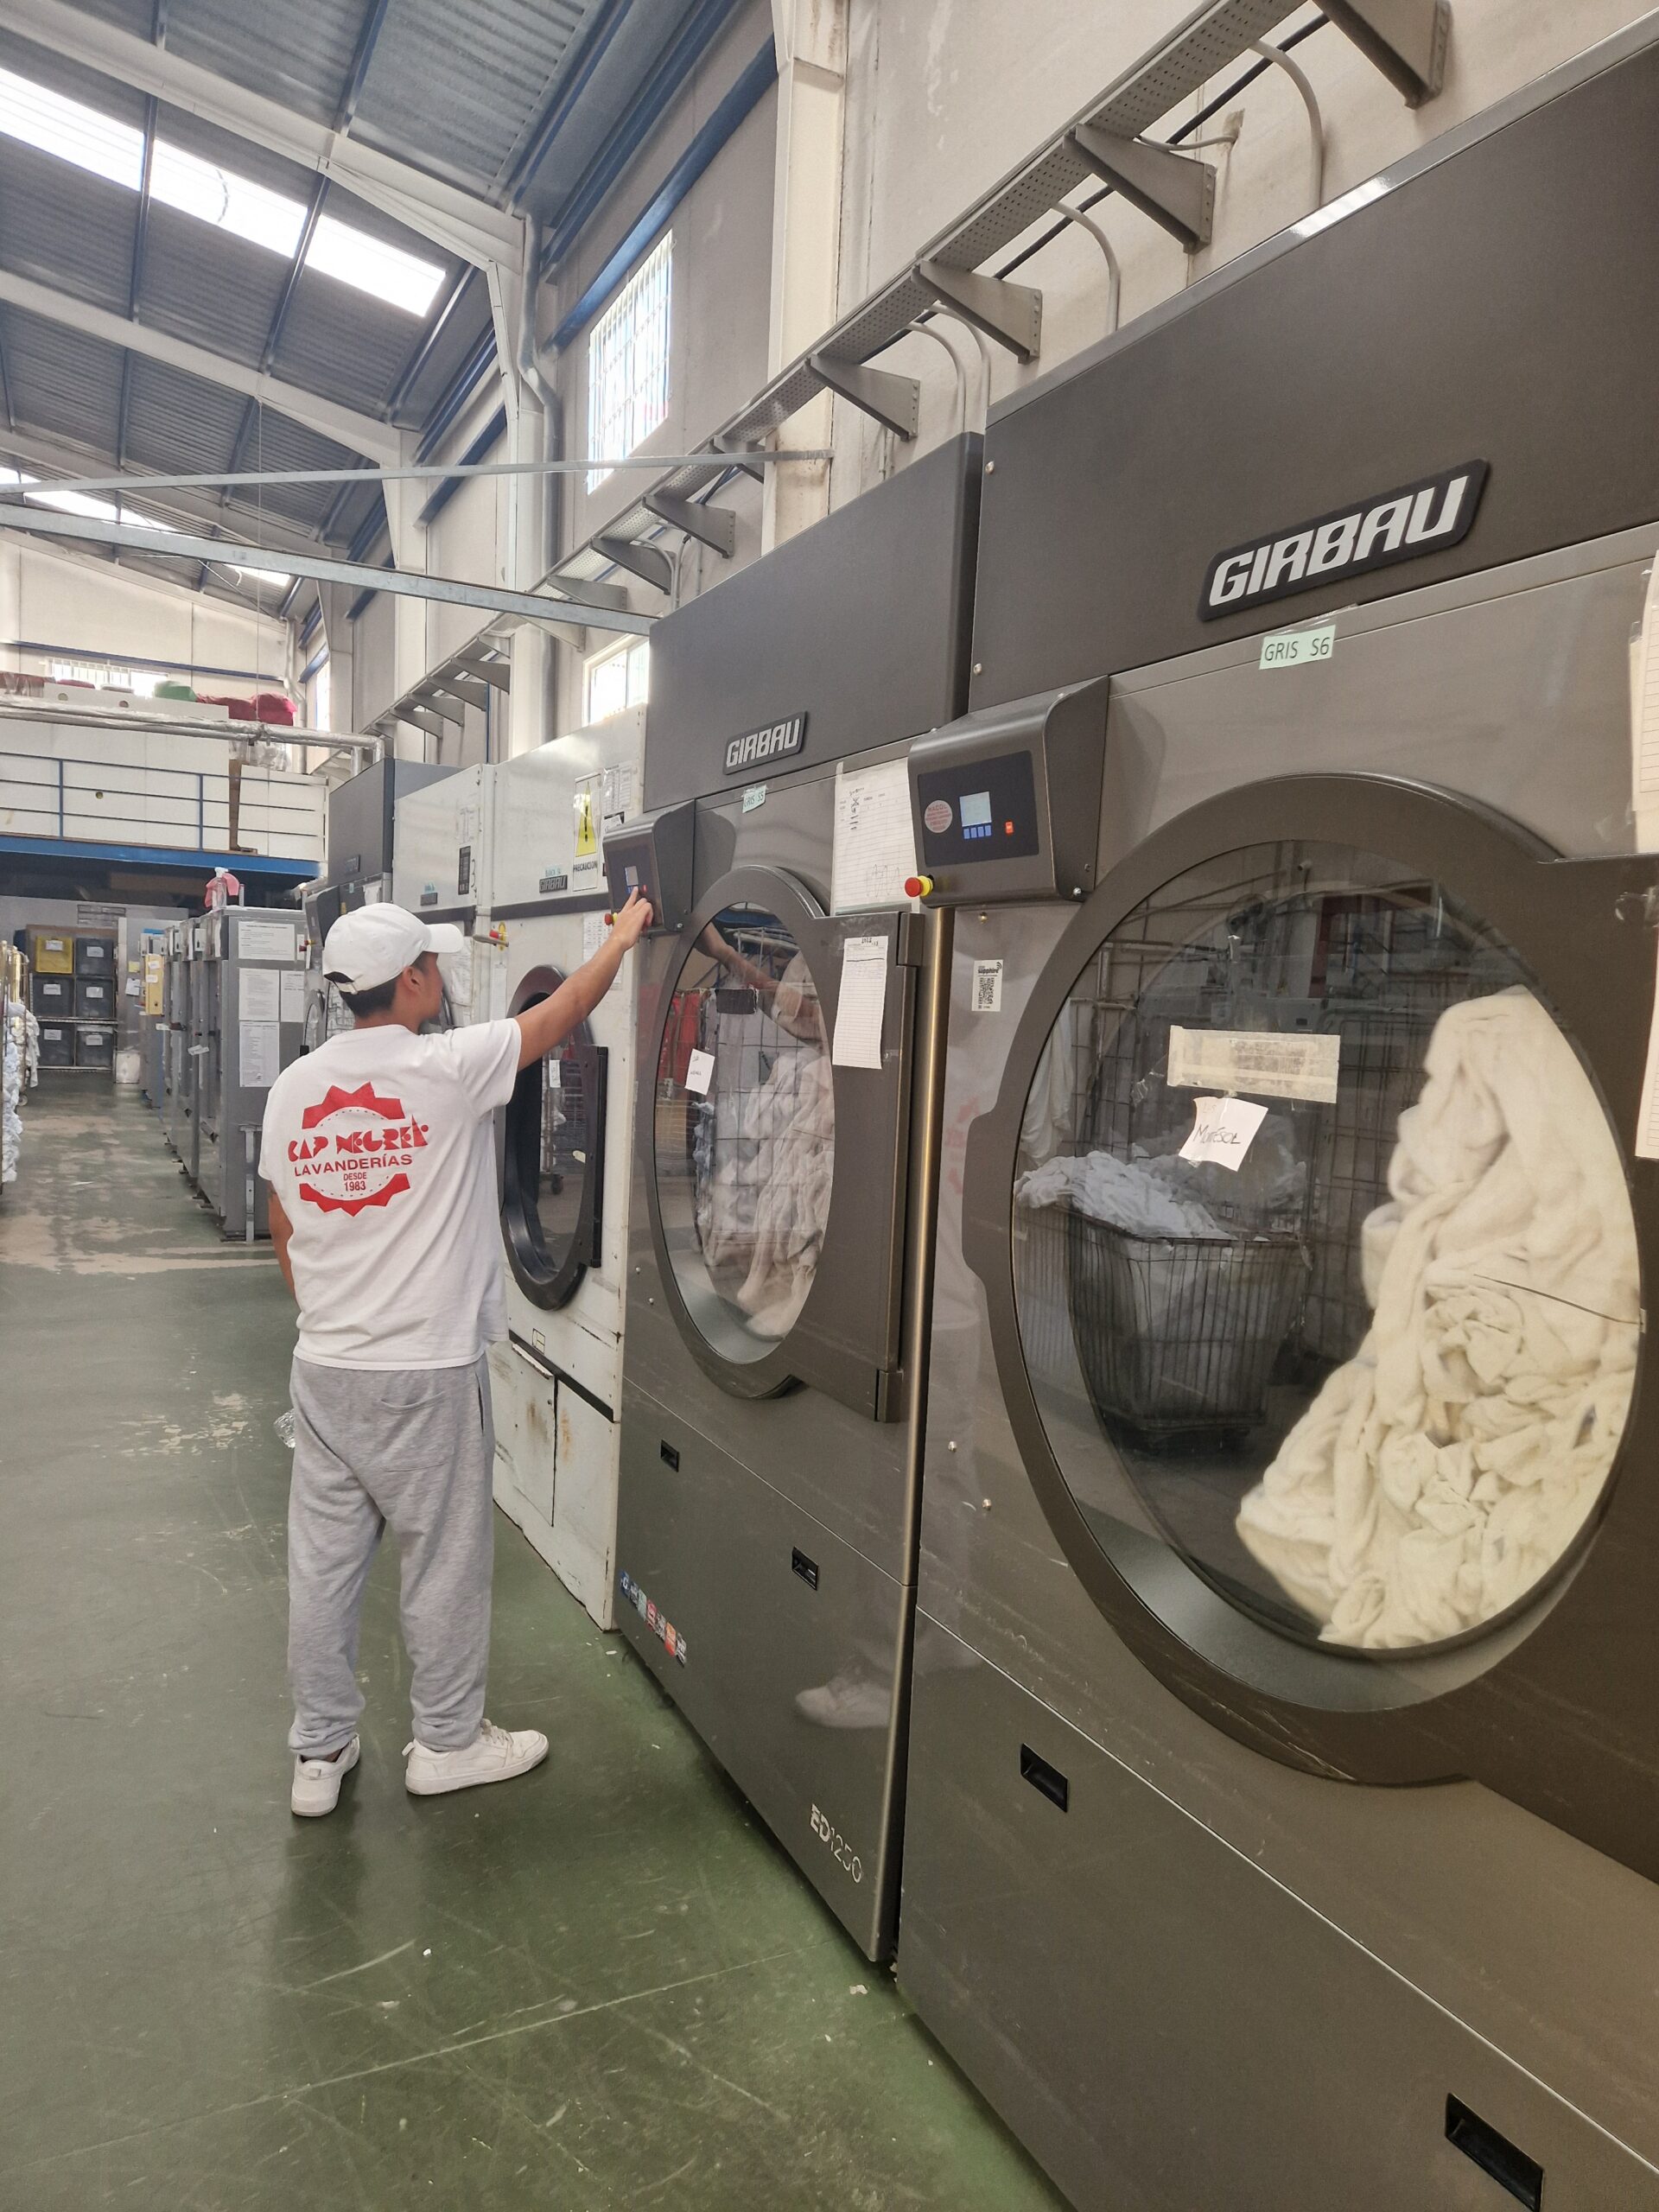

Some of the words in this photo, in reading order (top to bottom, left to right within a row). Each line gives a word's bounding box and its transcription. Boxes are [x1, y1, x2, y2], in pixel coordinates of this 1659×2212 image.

[1209, 475, 1468, 607] GIRBAU
[1264, 640, 1299, 662] GRIS
[1310, 638, 1331, 657] S6
[726, 718, 800, 767] GIRBAU
[539, 875, 566, 891] GIRBAU
[288, 1135, 329, 1162] CAP
[295, 1154, 412, 1177] LAVANDERÍAS
[343, 1172, 367, 1181] DESDE
[346, 1180, 366, 1192] 1983
